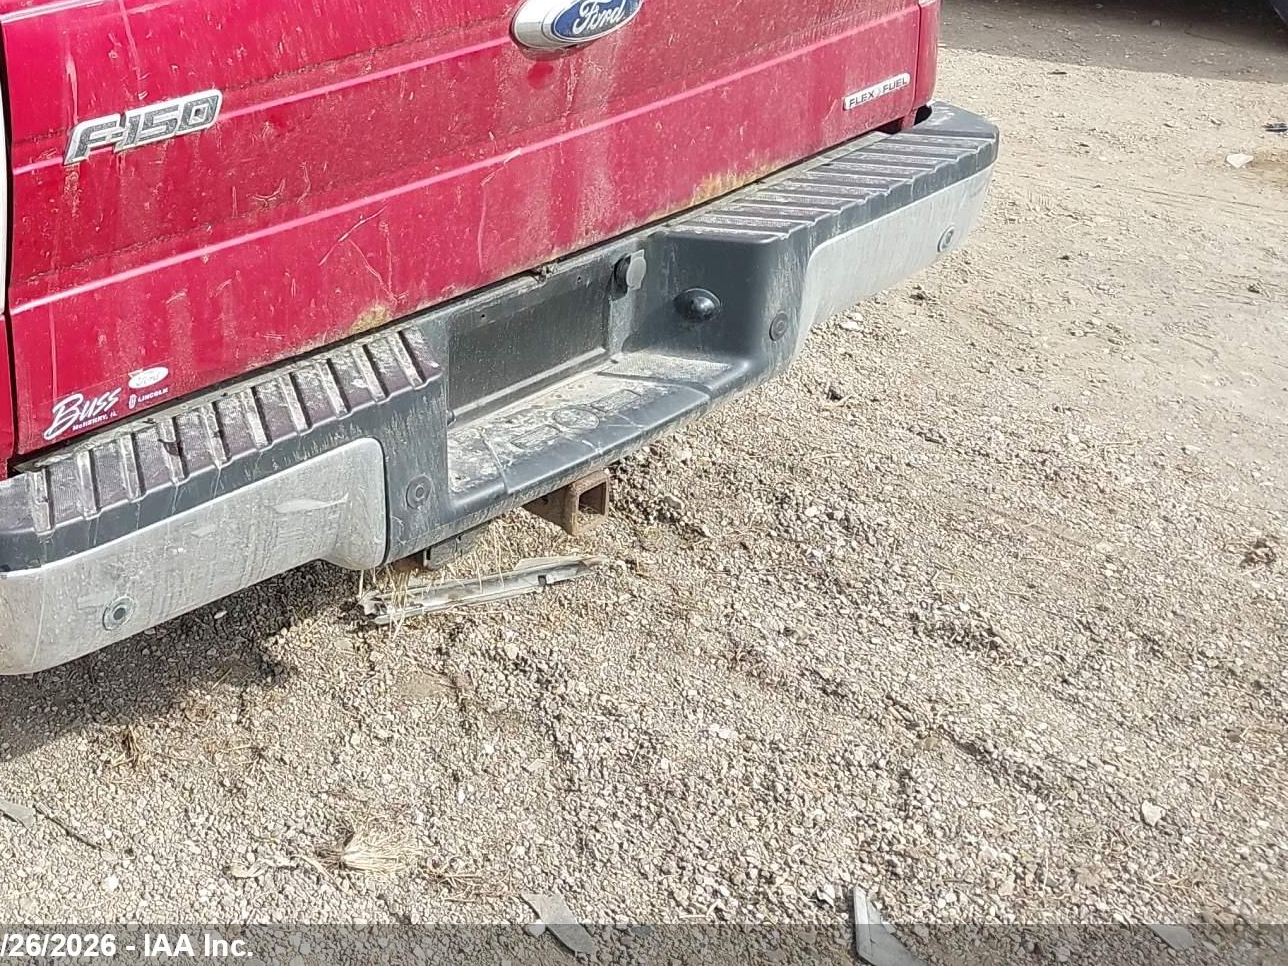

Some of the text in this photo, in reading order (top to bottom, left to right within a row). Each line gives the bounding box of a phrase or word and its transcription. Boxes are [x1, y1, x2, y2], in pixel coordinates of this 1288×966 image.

[849, 78, 908, 107] FLEX FUEL
[63, 88, 224, 166] F-150
